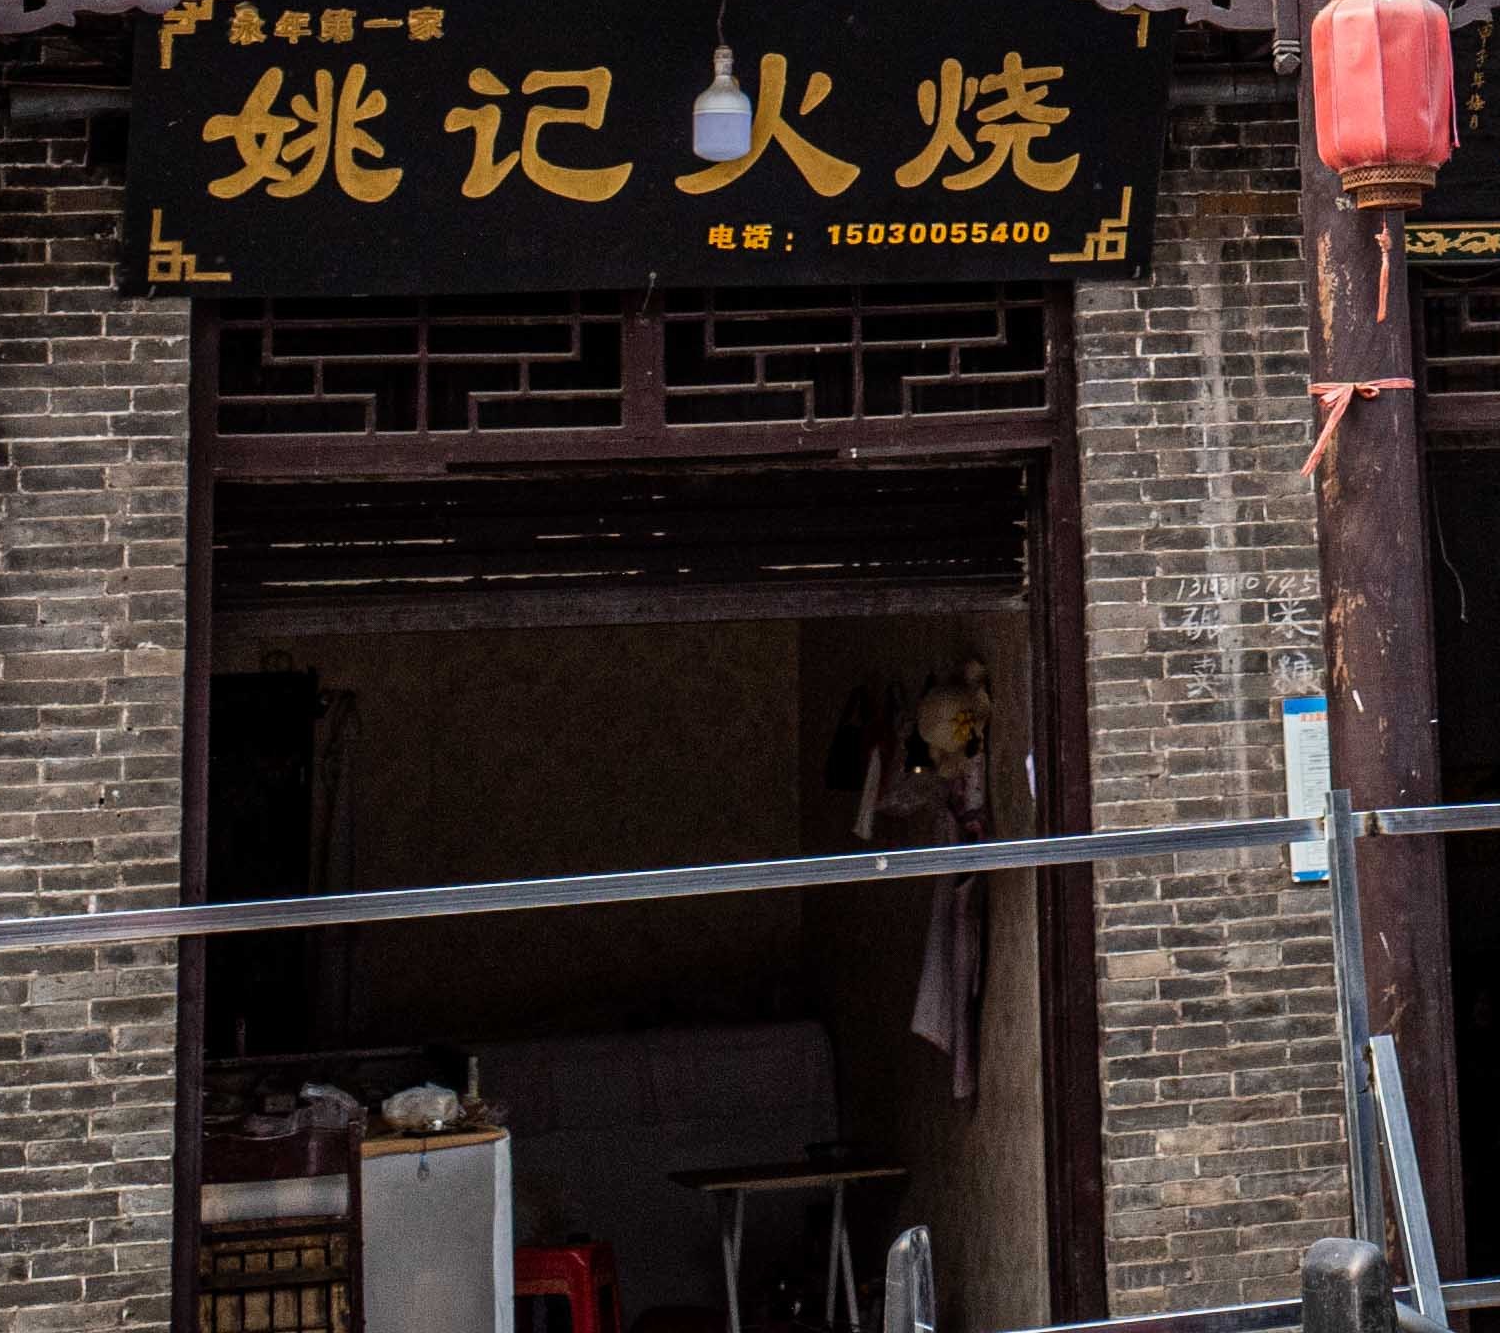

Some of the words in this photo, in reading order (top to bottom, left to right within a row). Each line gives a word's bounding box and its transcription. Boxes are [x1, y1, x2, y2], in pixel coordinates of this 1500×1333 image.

[229, 2, 445, 45] 永年第一家
[202, 52, 1080, 203] 姚记火烧
[827, 220, 1050, 246] 15030055400
